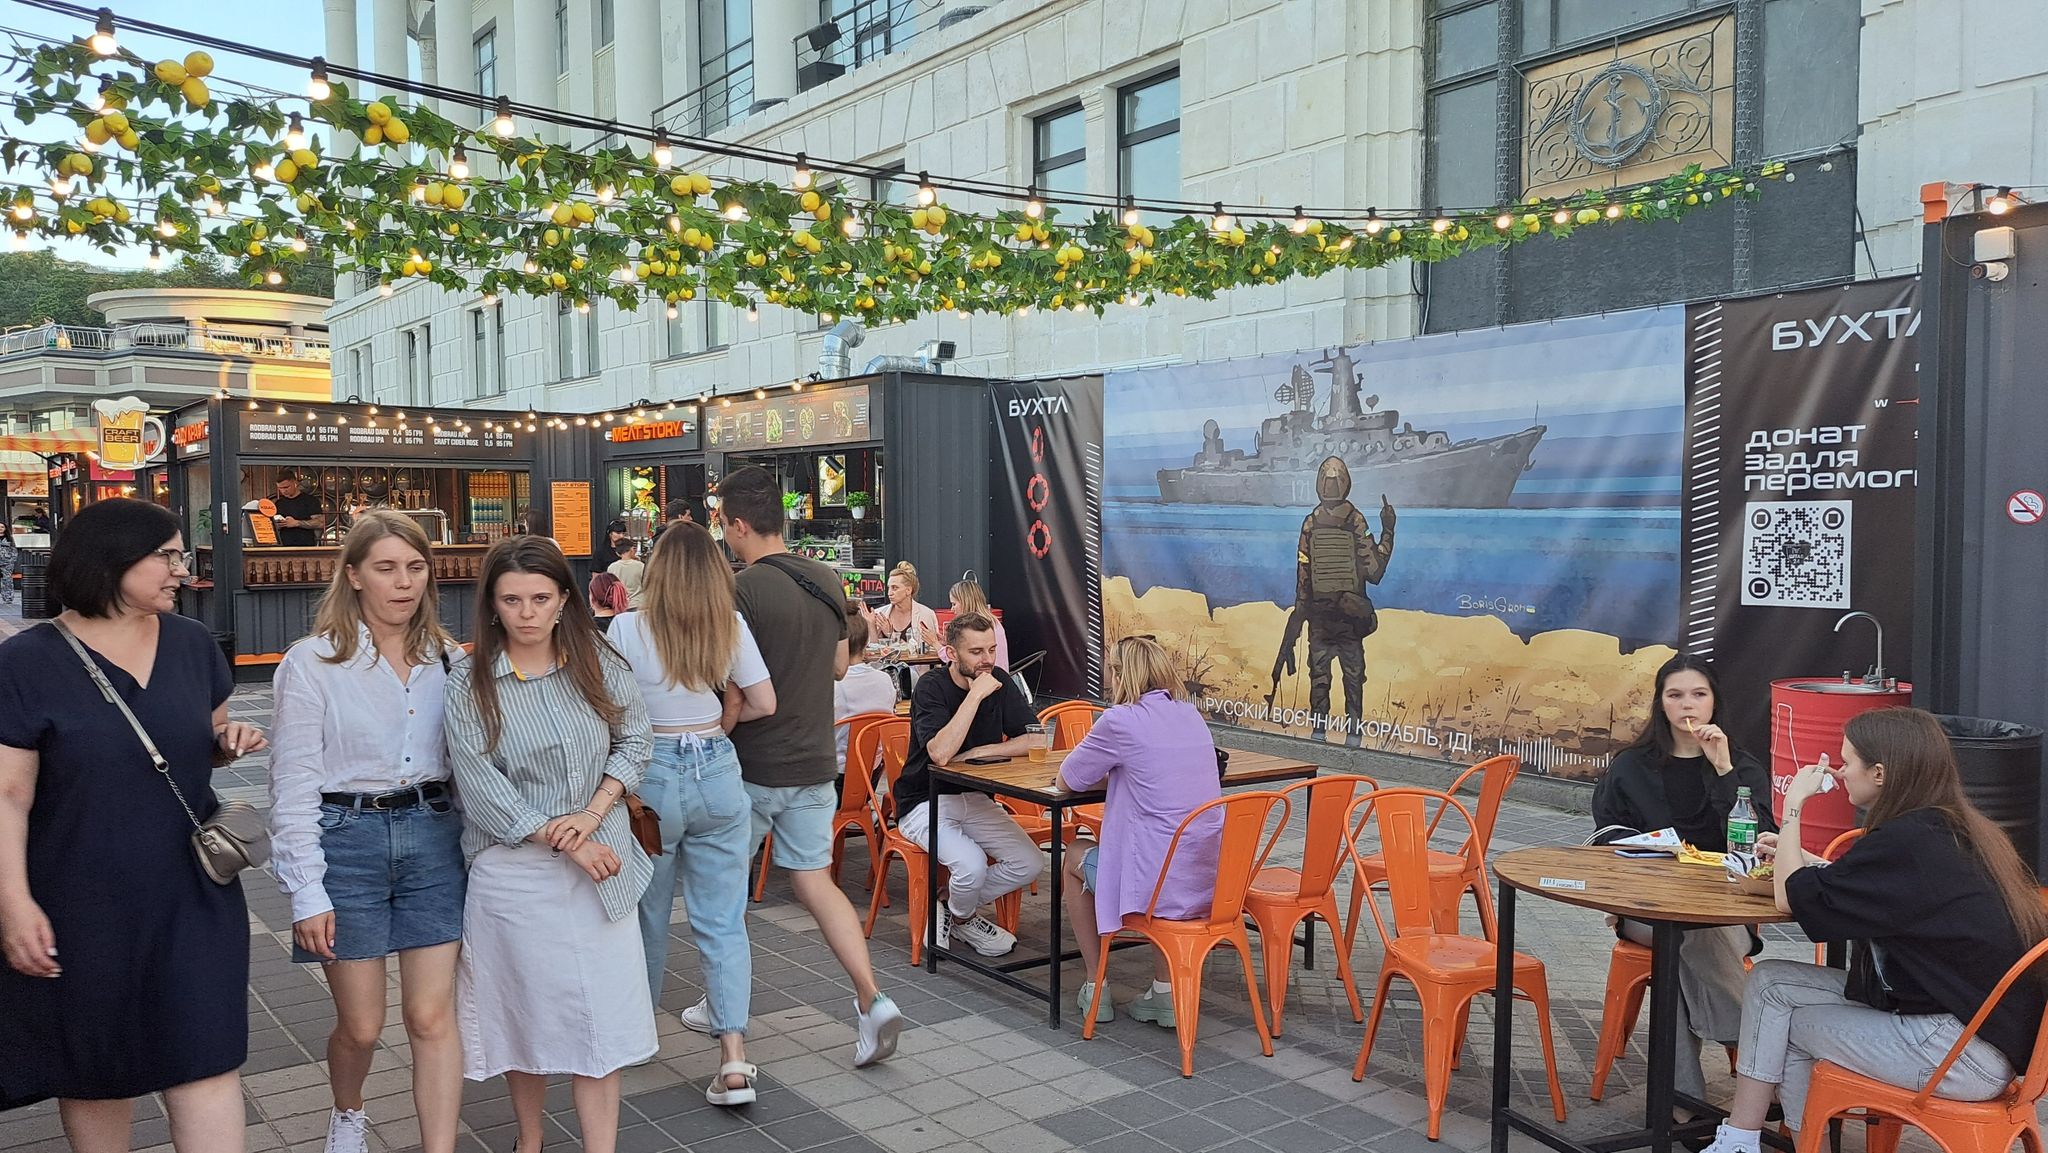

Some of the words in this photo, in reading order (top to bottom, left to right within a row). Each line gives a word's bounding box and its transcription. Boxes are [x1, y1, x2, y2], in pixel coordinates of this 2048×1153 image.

[105, 435, 139, 443] BEER
[277, 425, 297, 433] SILVER
[277, 433, 303, 441] BLANCHE
[612, 425, 642, 442] MEAT
[643, 420, 681, 440] STORY
[1745, 424, 1866, 452] донат
[1745, 450, 1859, 474] задля
[1744, 469, 1918, 496] перемог
[860, 579, 884, 592] ПІТА
[1206, 697, 1269, 721] РУССКІЙ
[1272, 707, 1352, 734] ВОЄННИЙ
[1356, 718, 1442, 750] КОРАБЛЬ,
[1448, 731, 1472, 755] ІДІ
